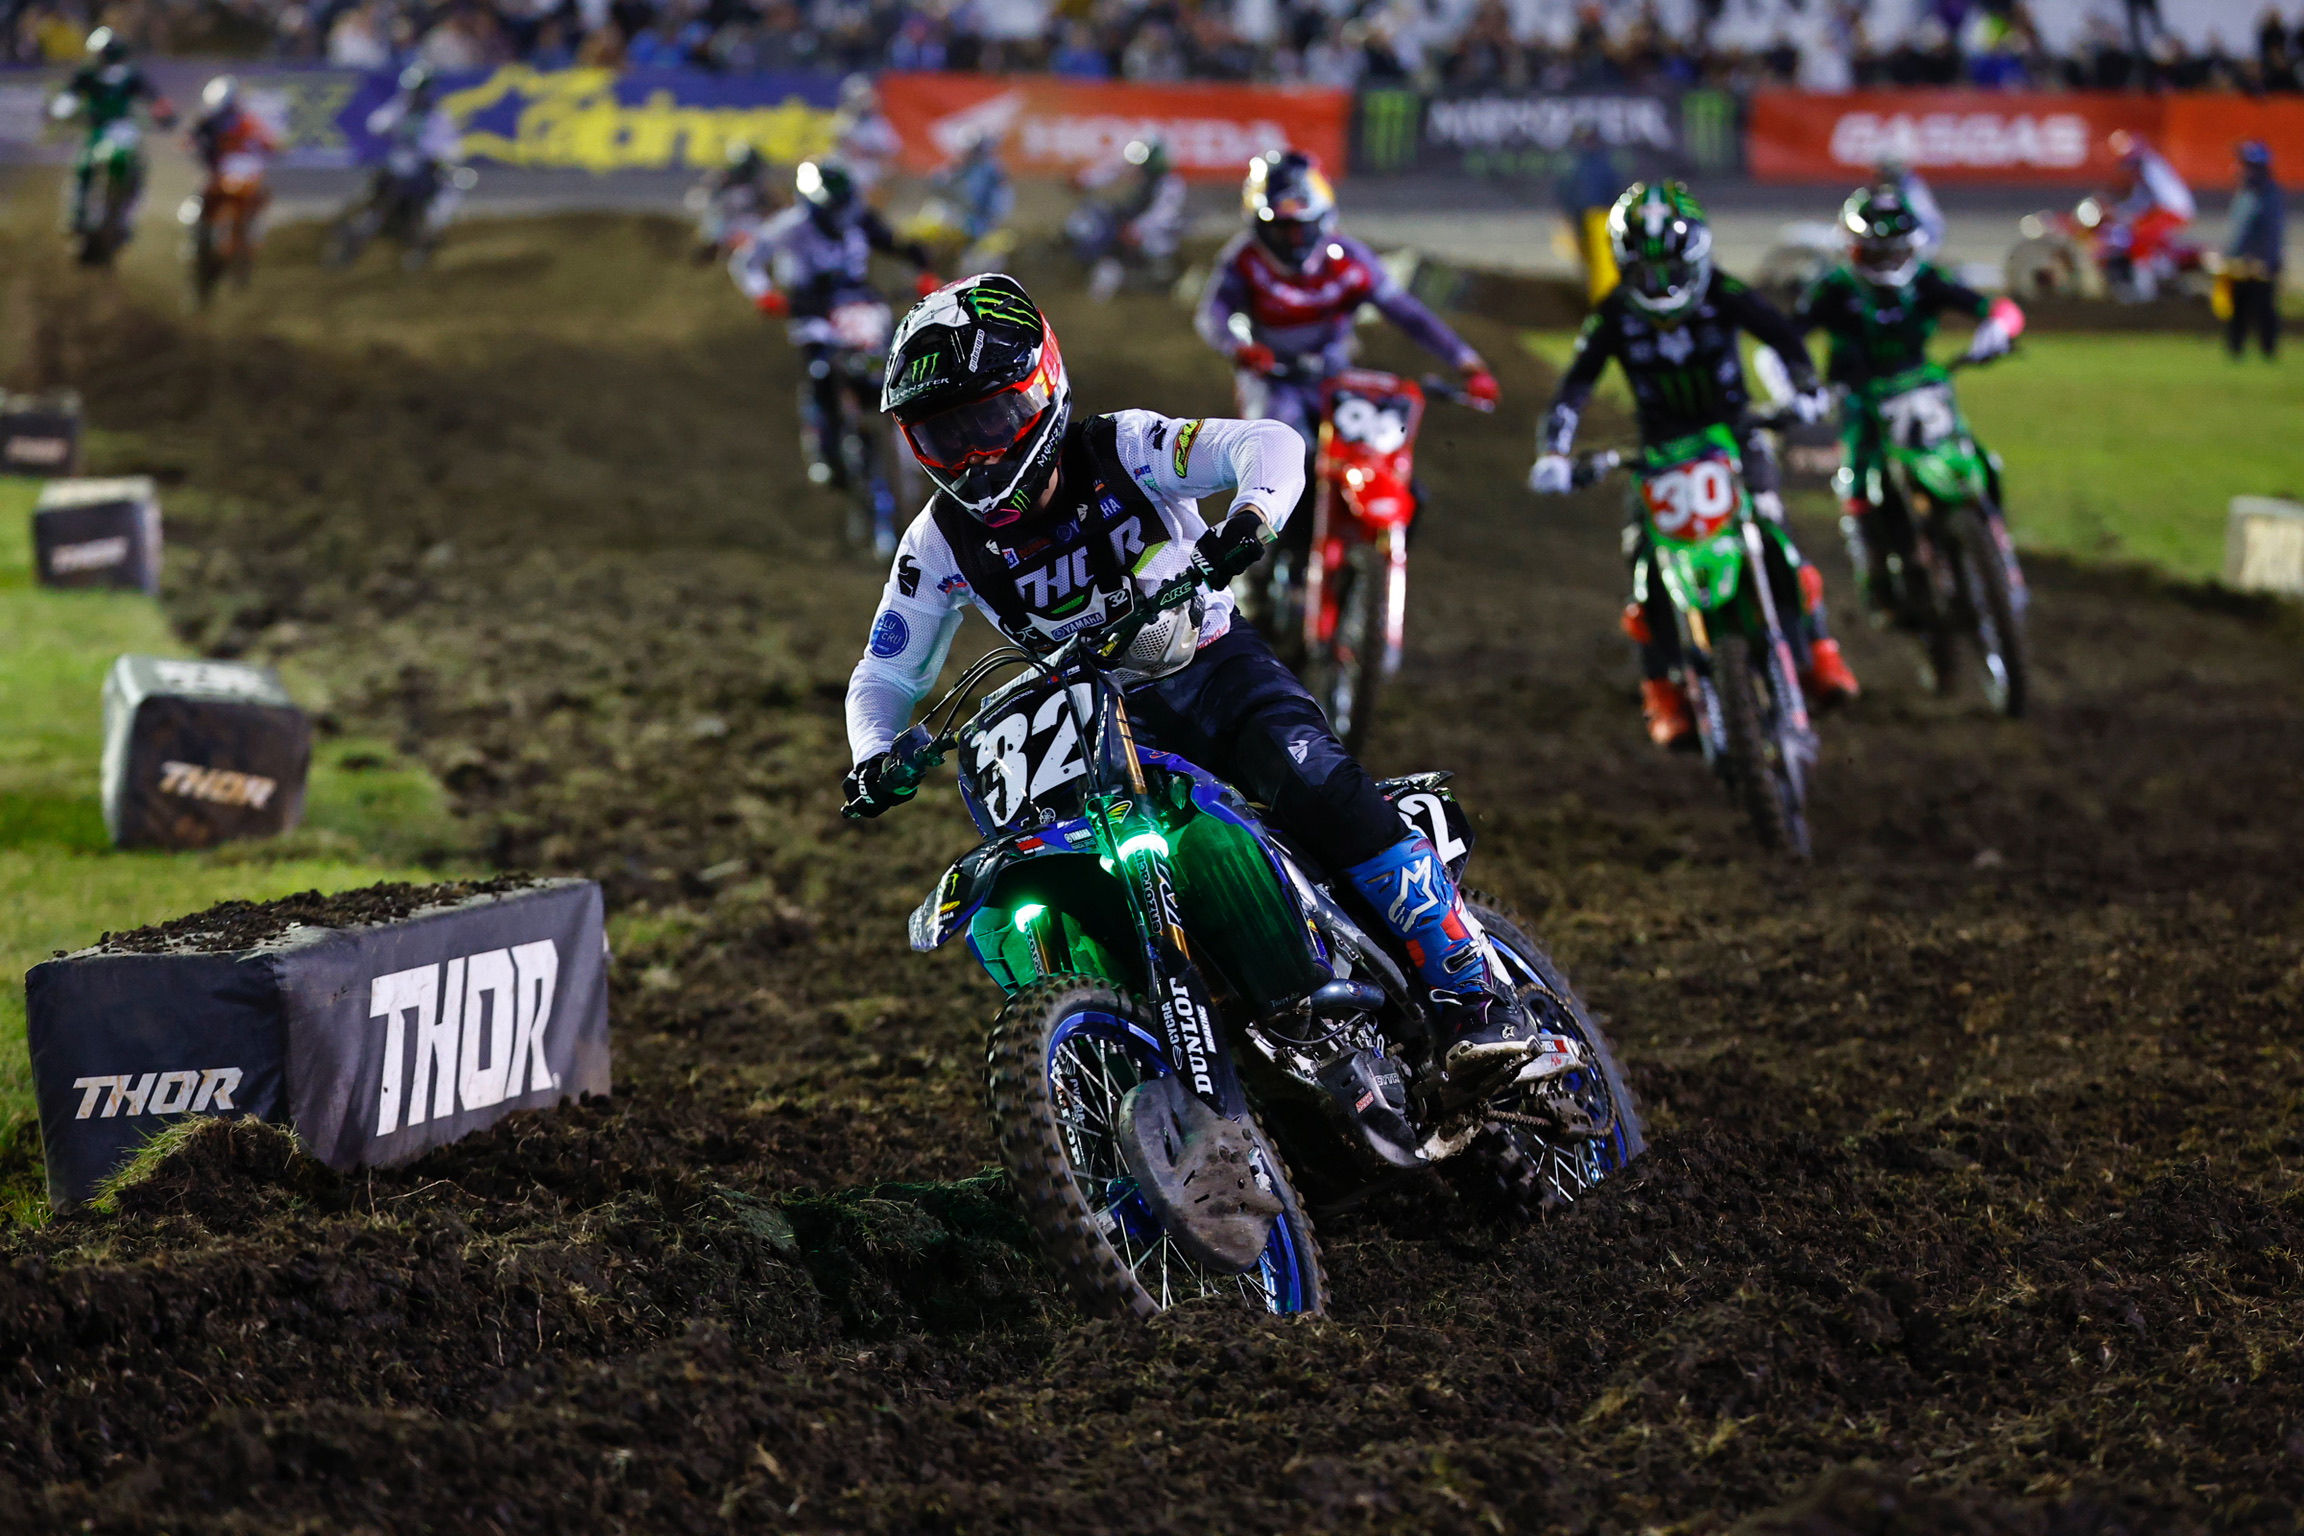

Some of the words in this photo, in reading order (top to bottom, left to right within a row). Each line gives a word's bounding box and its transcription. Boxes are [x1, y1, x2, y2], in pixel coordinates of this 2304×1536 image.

[968, 328, 985, 373] apdesigns
[1650, 461, 1732, 531] 30
[1108, 589, 1128, 608] 32
[1159, 581, 1192, 606] ARC
[1063, 612, 1104, 635] YAMAHA
[976, 682, 1094, 828] 32
[160, 761, 278, 810] THOR
[1397, 793, 1467, 863] 2
[1135, 849, 1162, 934] enzoracin
[369, 938, 559, 1137] THOR
[1161, 1001, 1179, 1045] CYCRA
[1196, 1004, 1217, 1054] BRAKING
[72, 1067, 243, 1121] THOR
